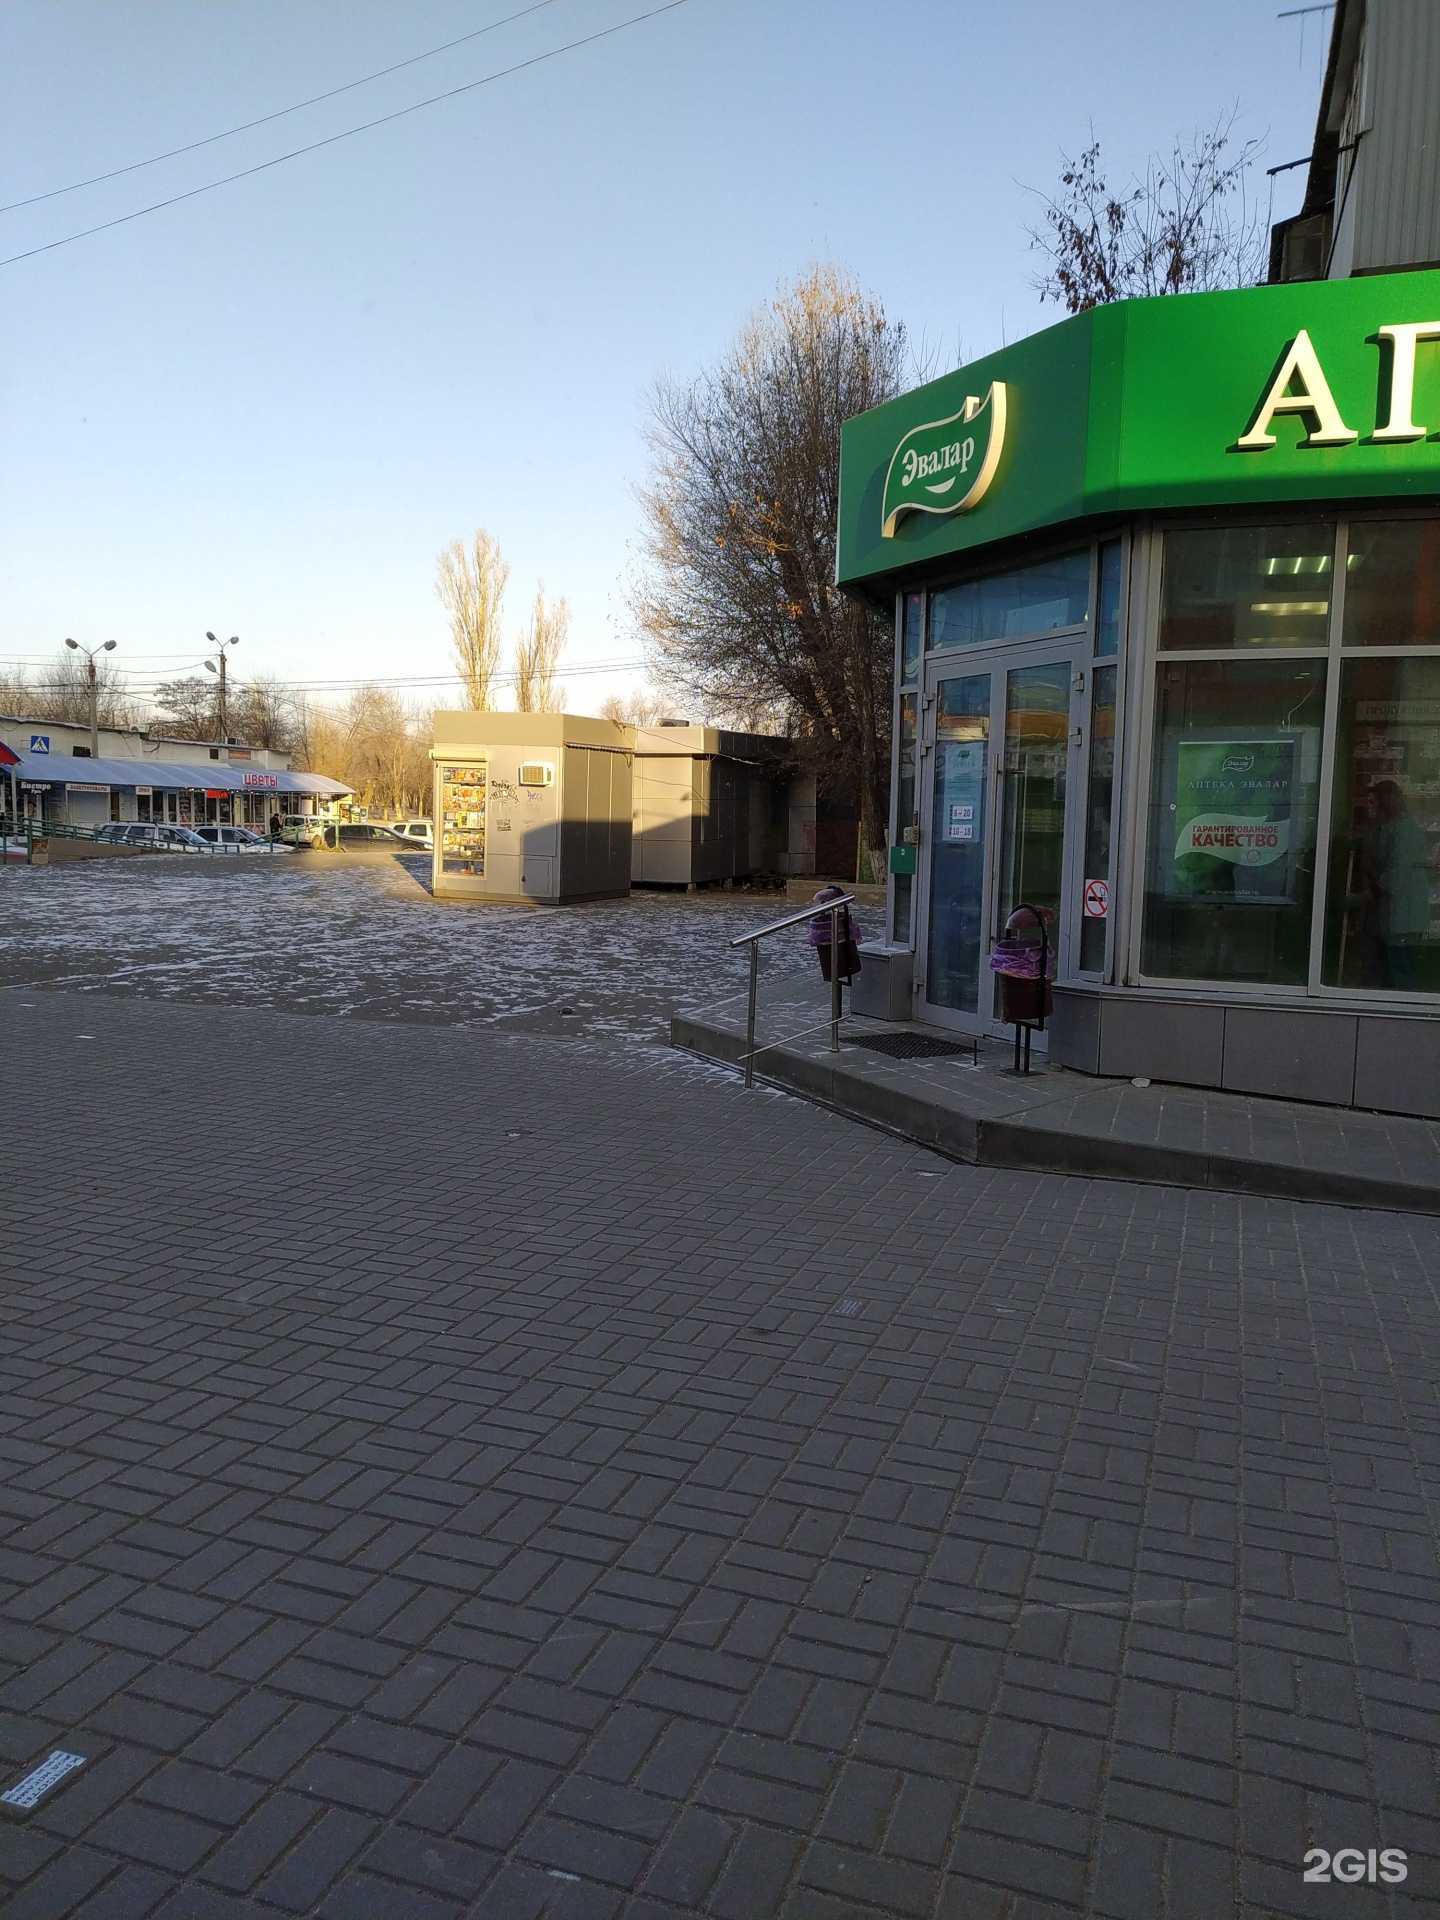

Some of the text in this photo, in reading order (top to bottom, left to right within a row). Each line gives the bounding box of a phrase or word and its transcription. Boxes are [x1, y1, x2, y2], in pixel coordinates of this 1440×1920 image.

[901, 436, 975, 487] Эвалар
[1188, 780, 1288, 789] АПТЕКА ЭВАЛАР
[1192, 825, 1279, 833] ГАРАНТИРОВАННОЕ
[1192, 834, 1279, 847] КАЧЕСТВО
